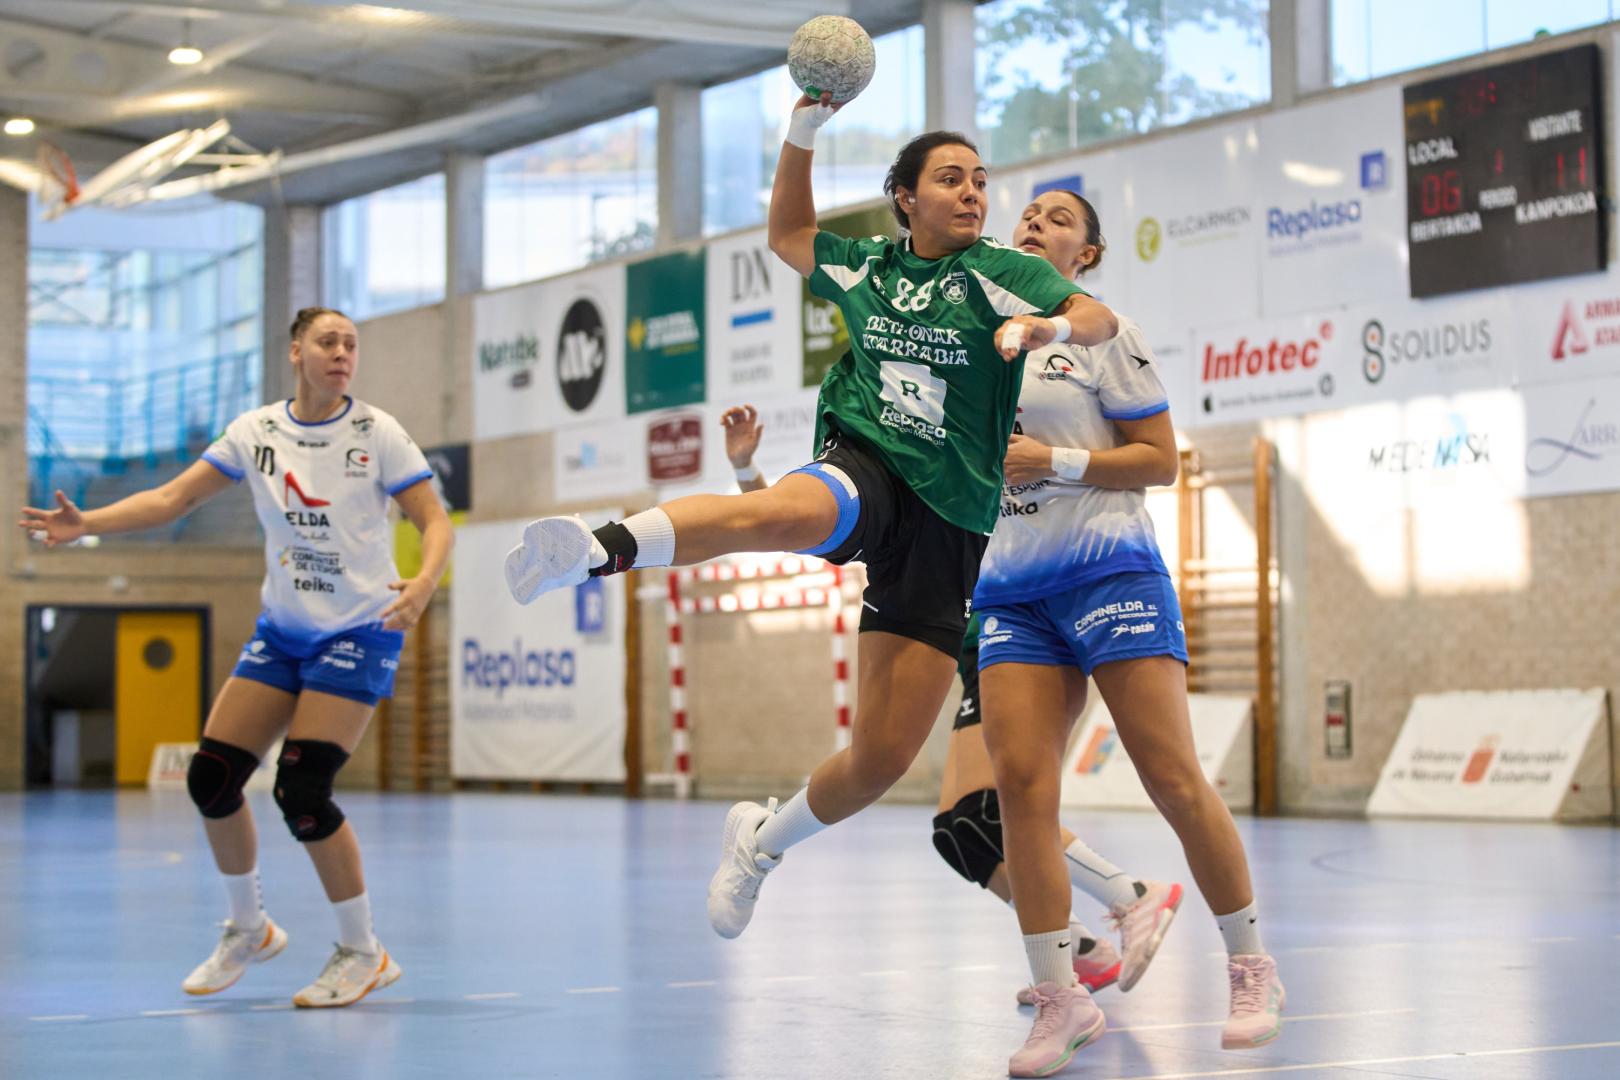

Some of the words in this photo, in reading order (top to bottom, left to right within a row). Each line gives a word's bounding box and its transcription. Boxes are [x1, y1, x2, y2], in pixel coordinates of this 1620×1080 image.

[1408, 138, 1458, 166] LOCAL
[1422, 170, 1461, 216] 06
[1267, 200, 1361, 238] Replasa
[892, 277, 935, 312] 88
[1389, 318, 1492, 364] SOLIDUS
[1202, 338, 1320, 382] Infotec
[901, 380, 921, 401] R
[880, 405, 947, 439] Replasa
[285, 512, 330, 527] ELDA
[294, 577, 335, 593] teika
[1075, 600, 1144, 631] CARPINELDA
[463, 637, 575, 698] Replasa
